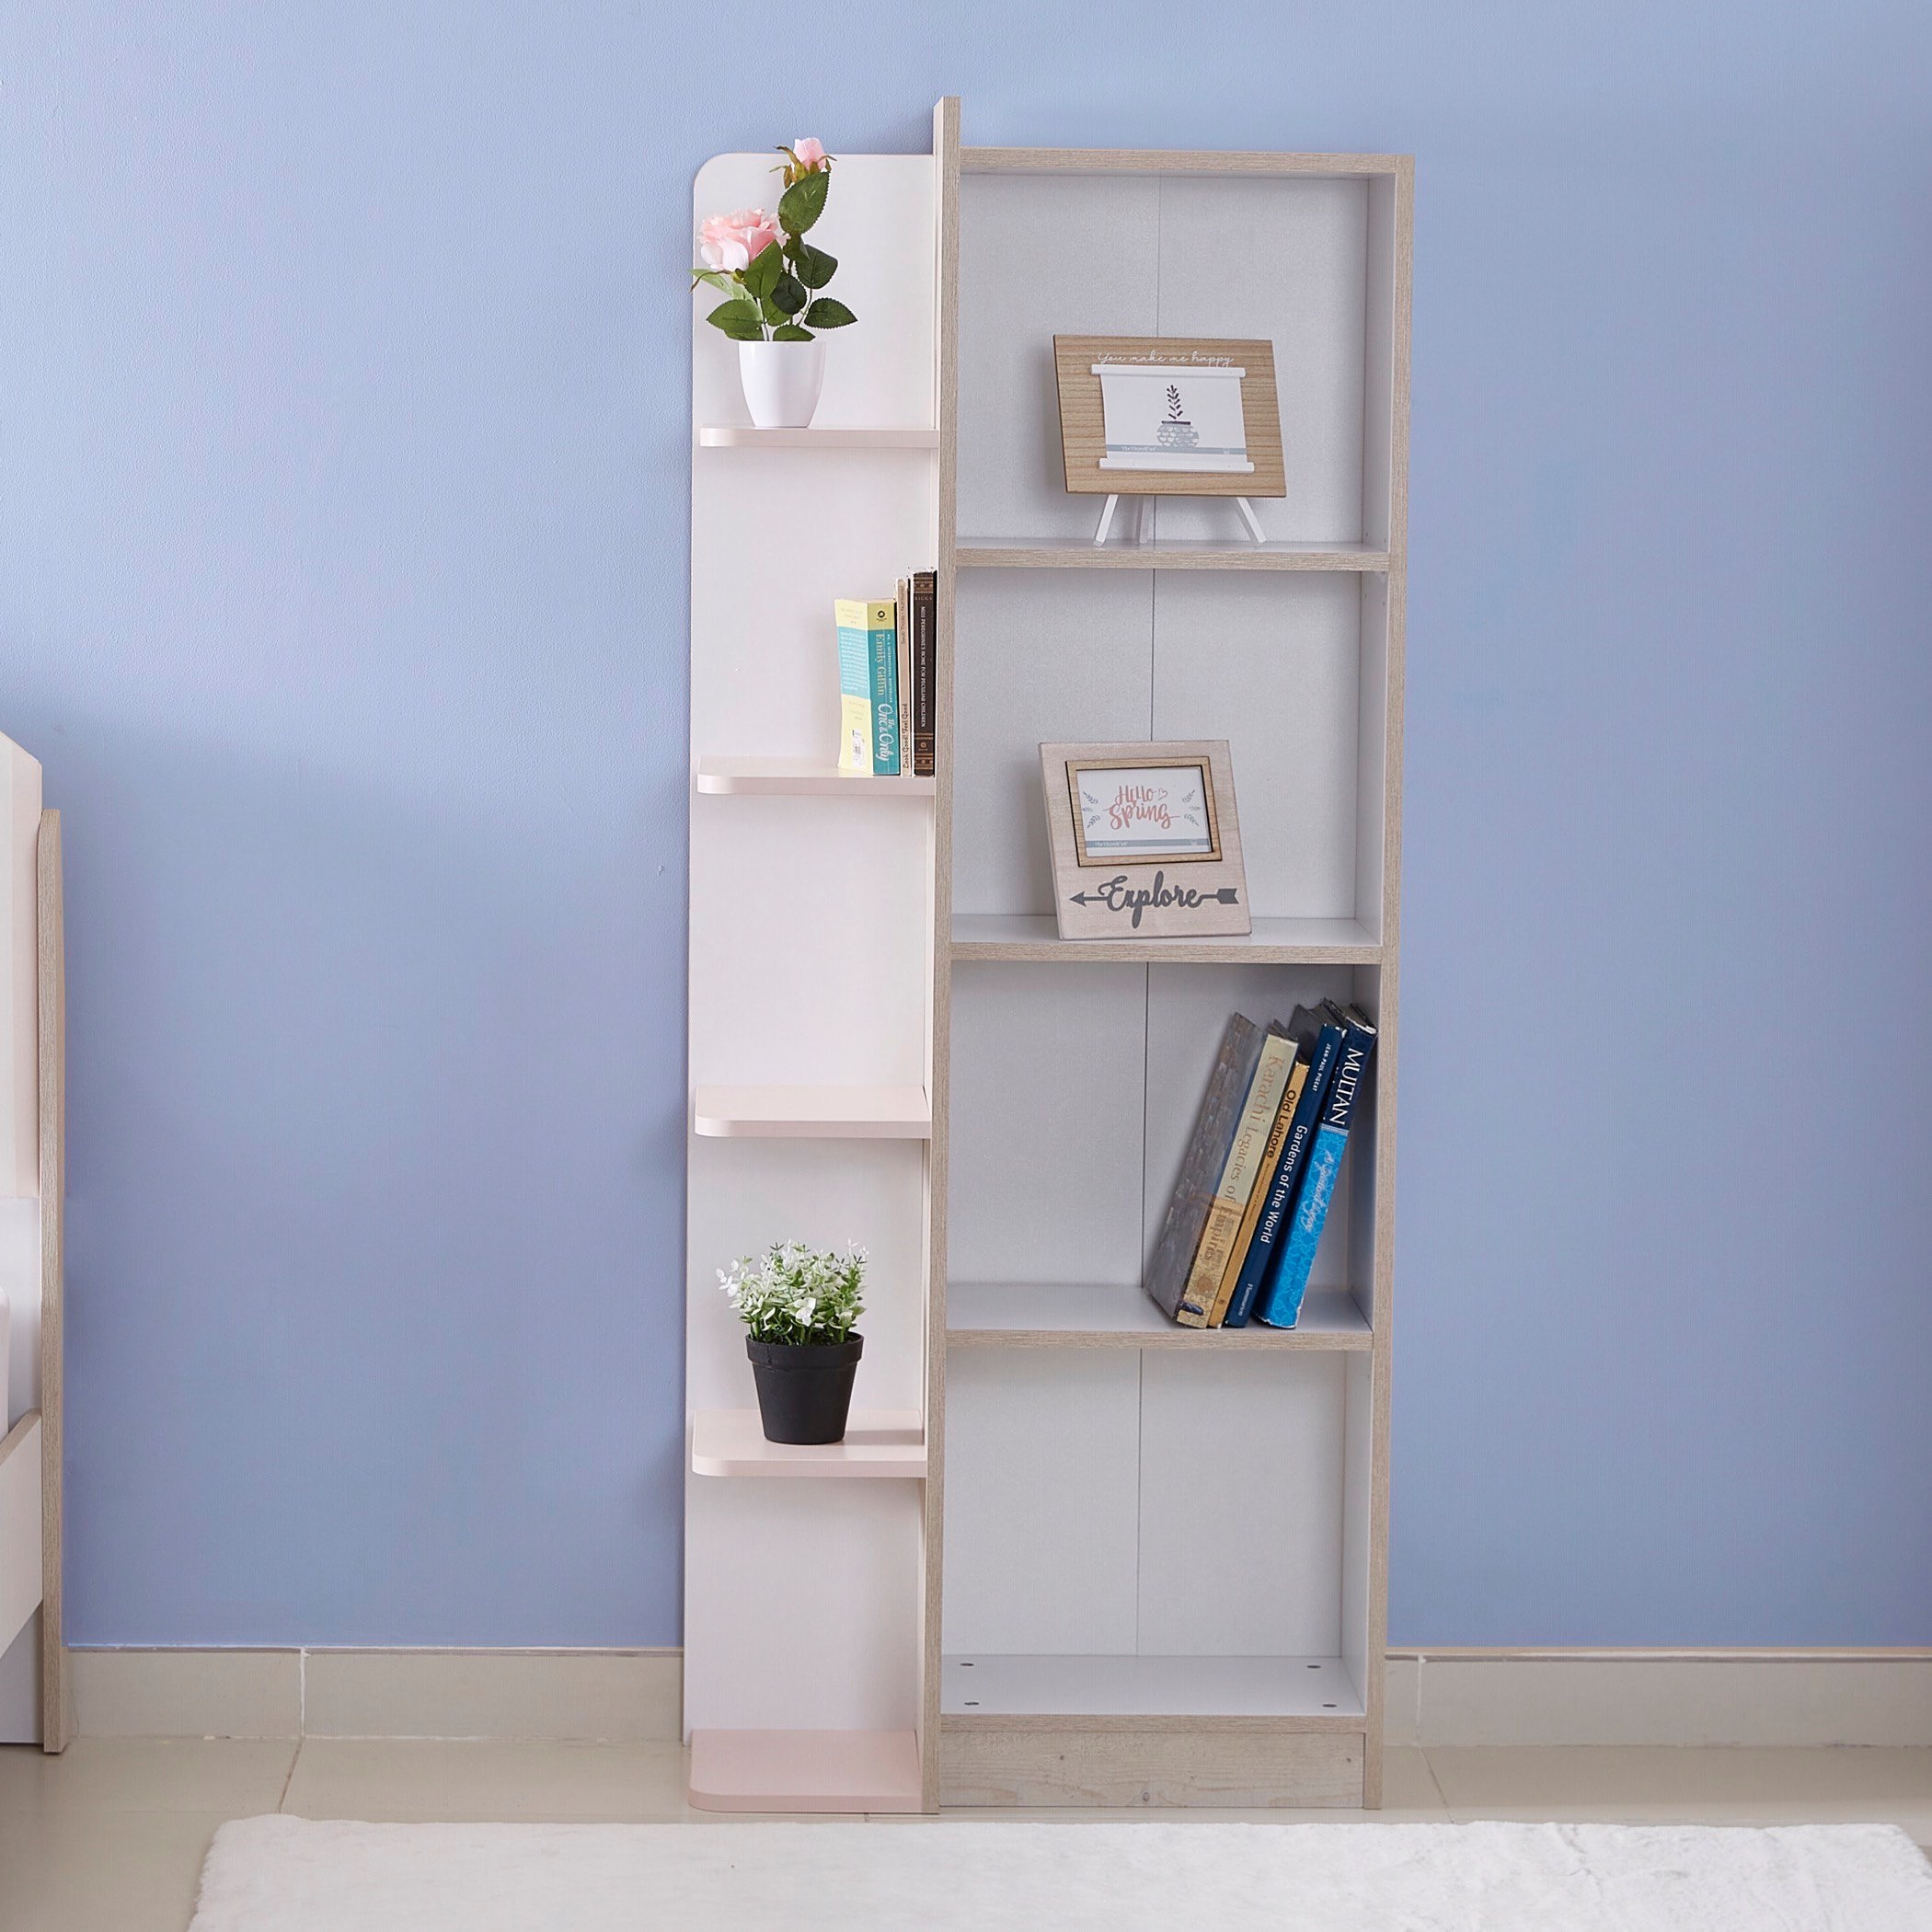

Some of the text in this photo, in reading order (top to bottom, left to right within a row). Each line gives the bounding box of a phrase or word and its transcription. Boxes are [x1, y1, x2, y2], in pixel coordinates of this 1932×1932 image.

[1098, 350, 1234, 368] You make me happy
[875, 634, 885, 663] Emily
[877, 666, 887, 696] Giffin
[878, 703, 893, 725] One
[875, 733, 894, 762] Only
[1115, 785, 1157, 806] Hello
[1103, 802, 1180, 830] Spring
[1098, 870, 1202, 929] Explore
[1318, 1043, 1331, 1071] JEAN-PAUL
[1250, 1055, 1285, 1122] Karachi
[1328, 1048, 1364, 1125] MULTAN
[1266, 1089, 1296, 1158] Old Lahore
[1230, 1126, 1259, 1181] Legacies
[1224, 1185, 1236, 1203] of
[1260, 1125, 1308, 1244] Gardens of the World
